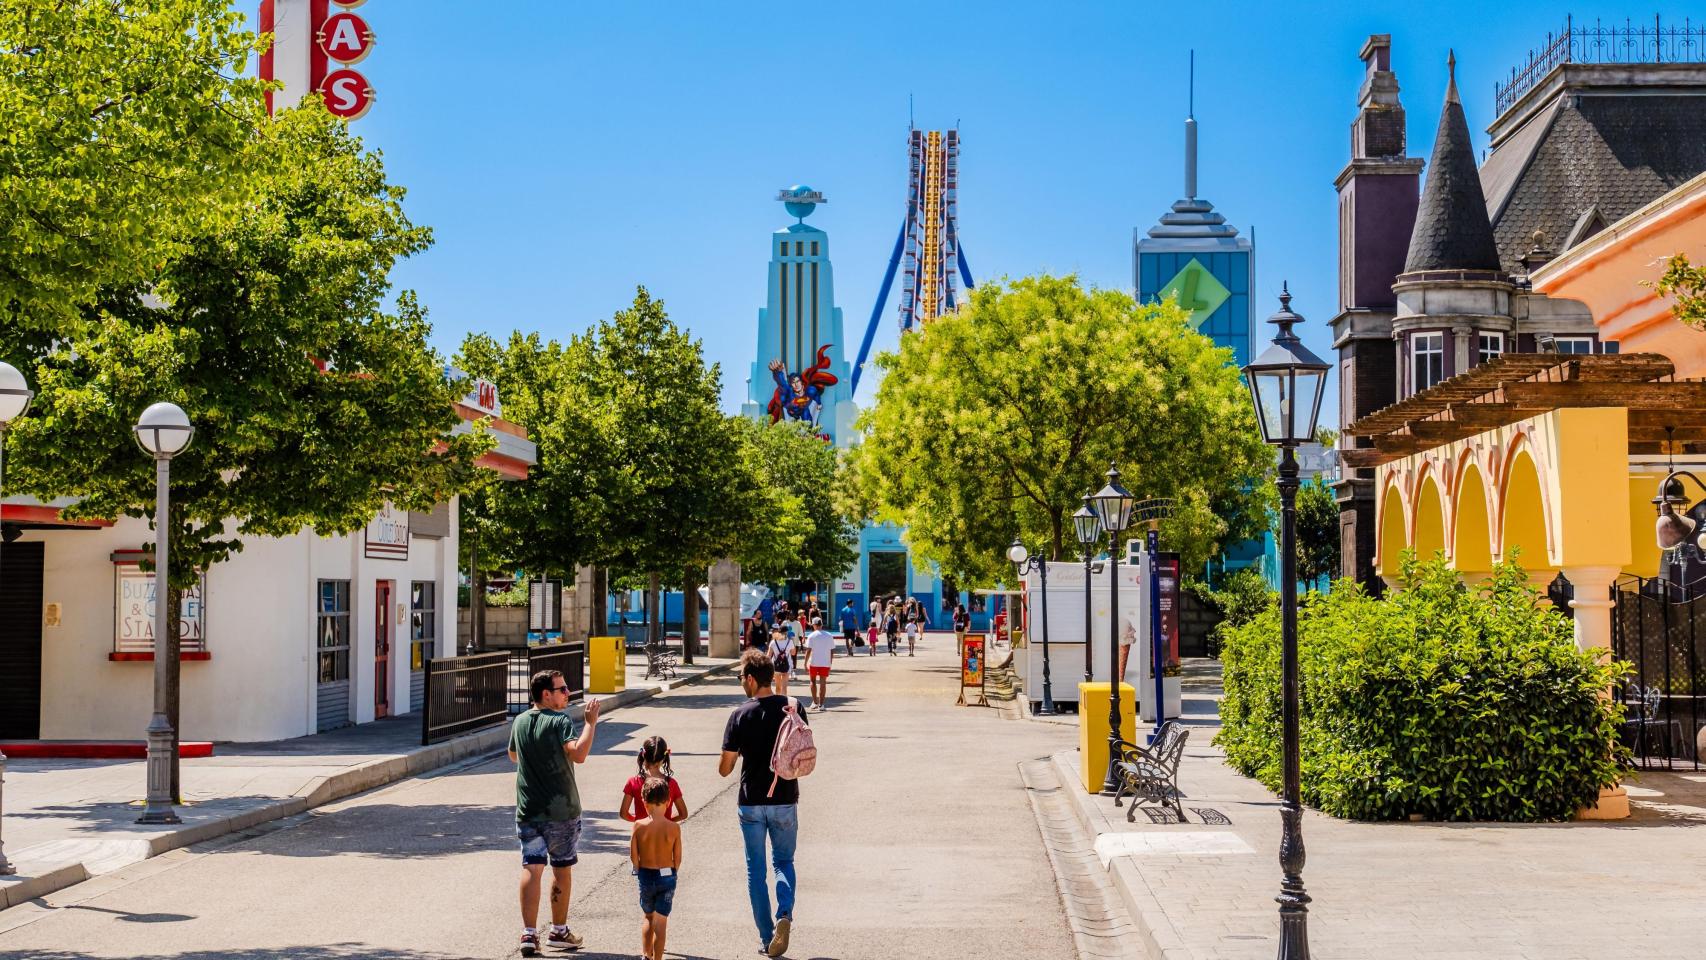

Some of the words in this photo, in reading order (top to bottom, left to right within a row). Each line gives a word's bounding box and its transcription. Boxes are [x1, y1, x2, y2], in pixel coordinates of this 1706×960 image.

[1181, 269, 1209, 310] L
[131, 603, 141, 616] &
[123, 616, 200, 637] STAON
